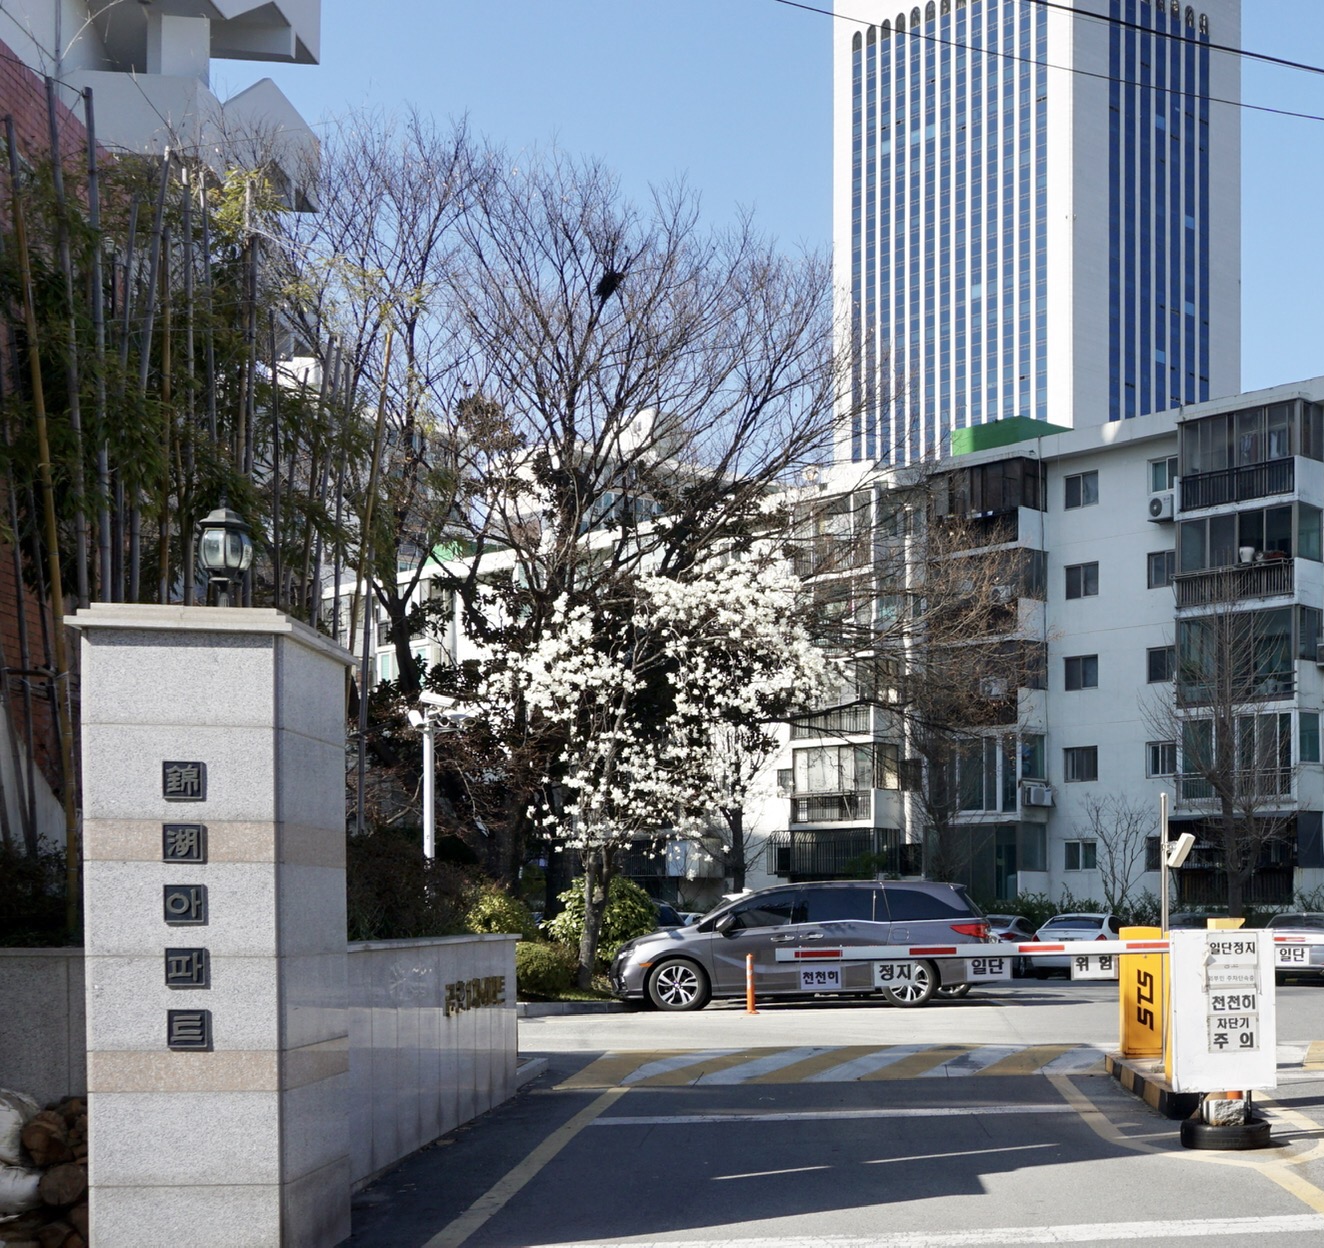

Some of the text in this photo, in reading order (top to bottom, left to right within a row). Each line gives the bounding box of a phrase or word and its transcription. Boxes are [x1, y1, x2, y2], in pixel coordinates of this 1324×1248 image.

[1209, 941, 1256, 955] 일단정지
[1279, 947, 1305, 962] 일단
[879, 963, 912, 981] 정지
[971, 958, 1005, 975] 일단
[802, 970, 839, 985] 천천히
[1211, 993, 1256, 1011] 천천히
[1216, 1016, 1250, 1030] 차단기
